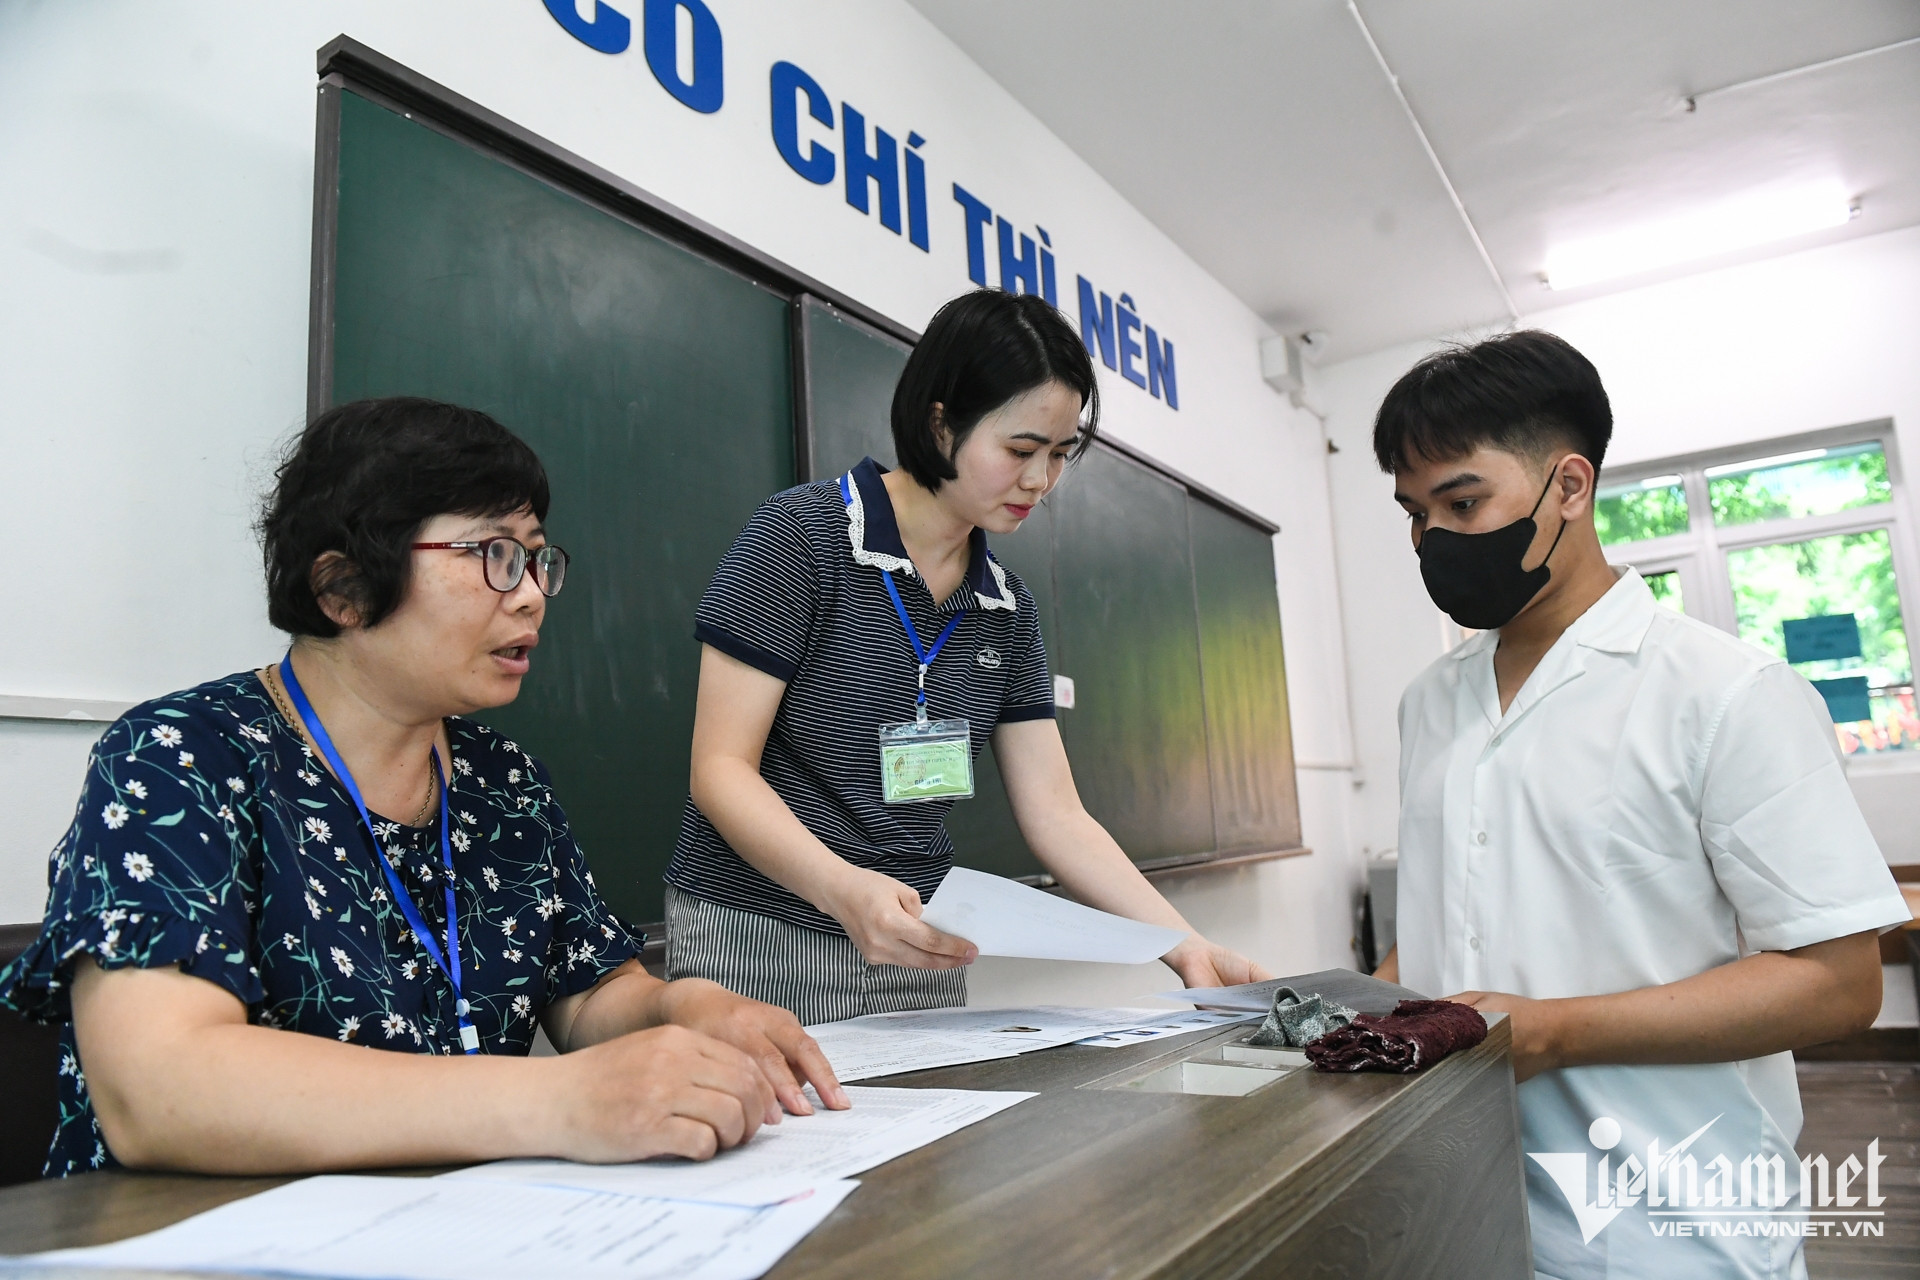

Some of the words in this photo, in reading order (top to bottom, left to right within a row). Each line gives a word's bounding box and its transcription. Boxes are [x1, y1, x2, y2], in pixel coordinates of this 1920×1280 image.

[770, 60, 929, 253] CHÍ
[952, 181, 1057, 309] THÌ
[1076, 272, 1179, 411] NÊN
